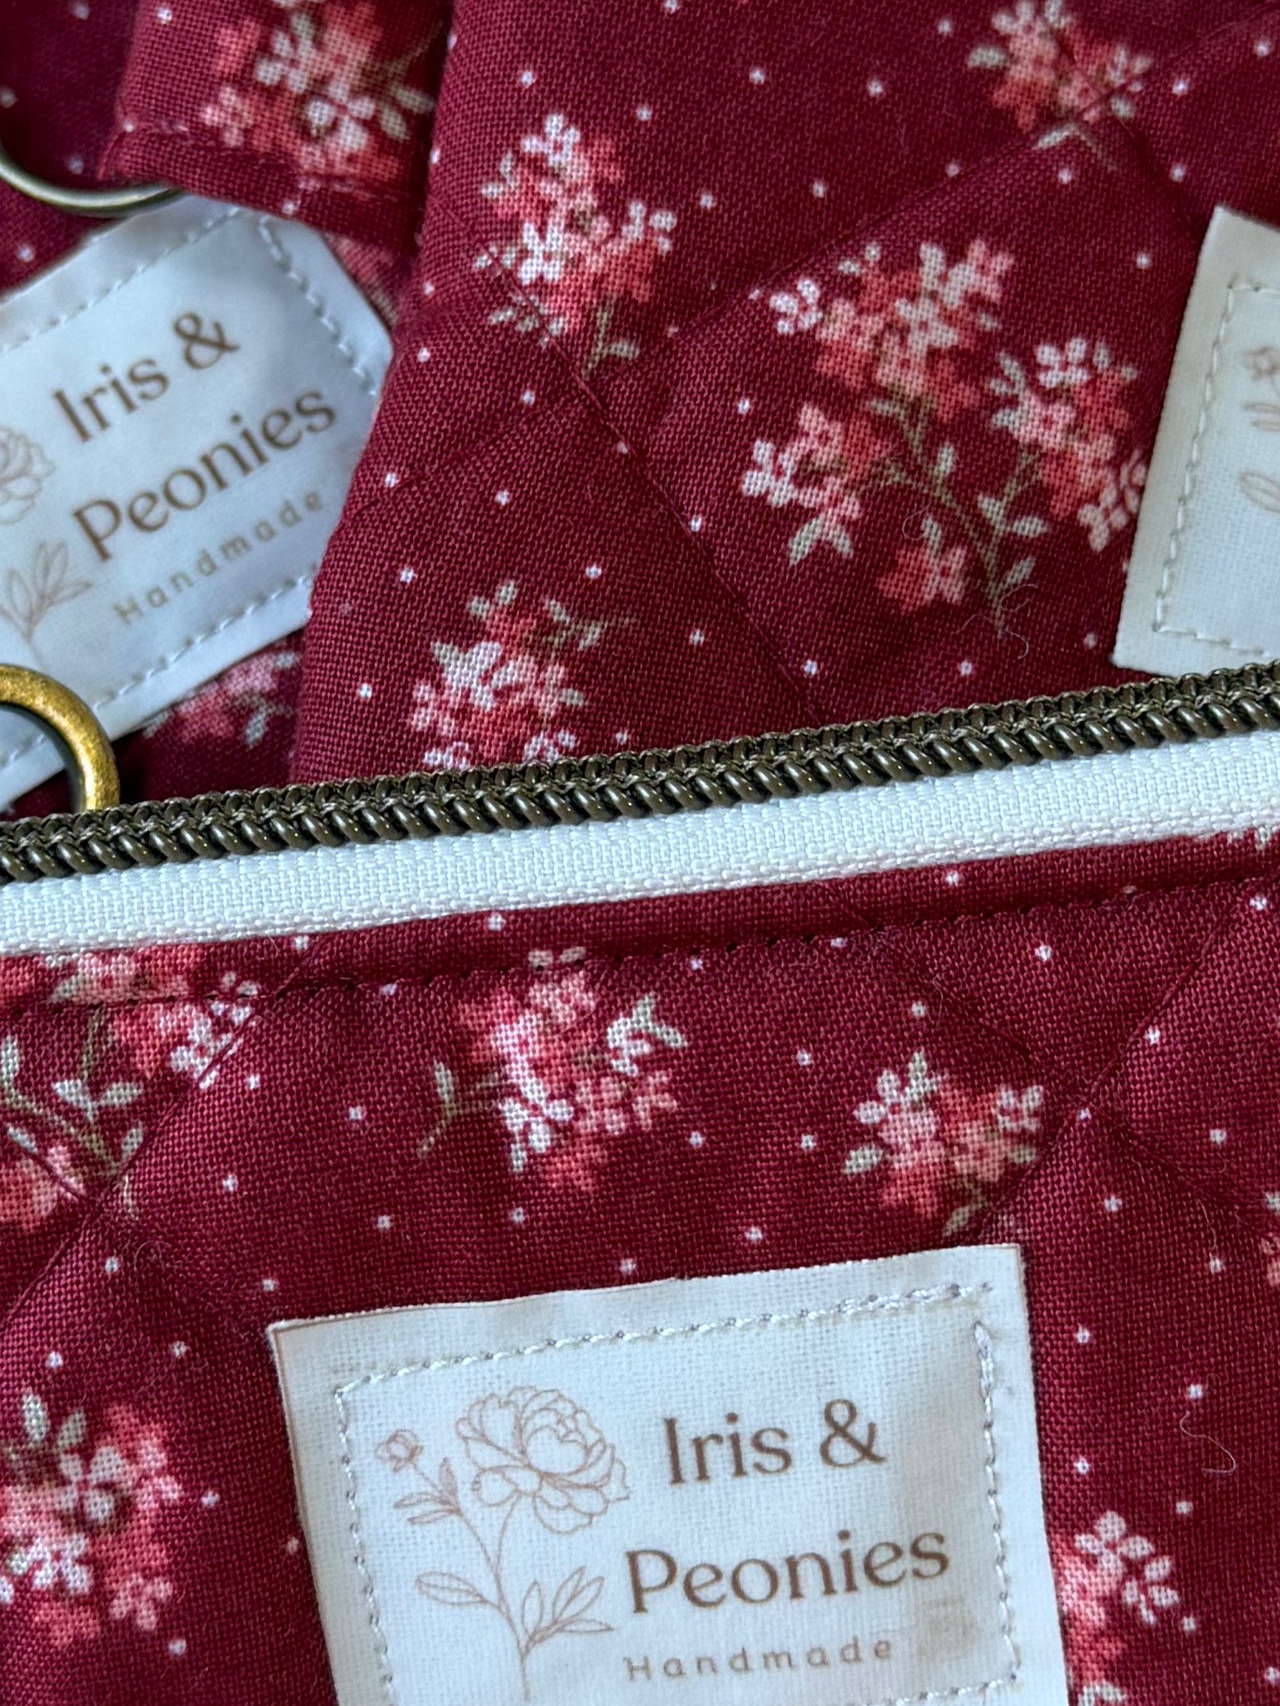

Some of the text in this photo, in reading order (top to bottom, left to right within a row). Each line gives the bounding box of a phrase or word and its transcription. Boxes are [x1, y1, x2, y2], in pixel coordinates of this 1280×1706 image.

[51, 311, 241, 444] Iris &
[71, 387, 338, 563] Peonies
[113, 489, 324, 625] Handmade
[662, 1397, 888, 1487] Iris &
[624, 1529, 951, 1615] Peonies
[622, 1634, 893, 1683] Handmade
